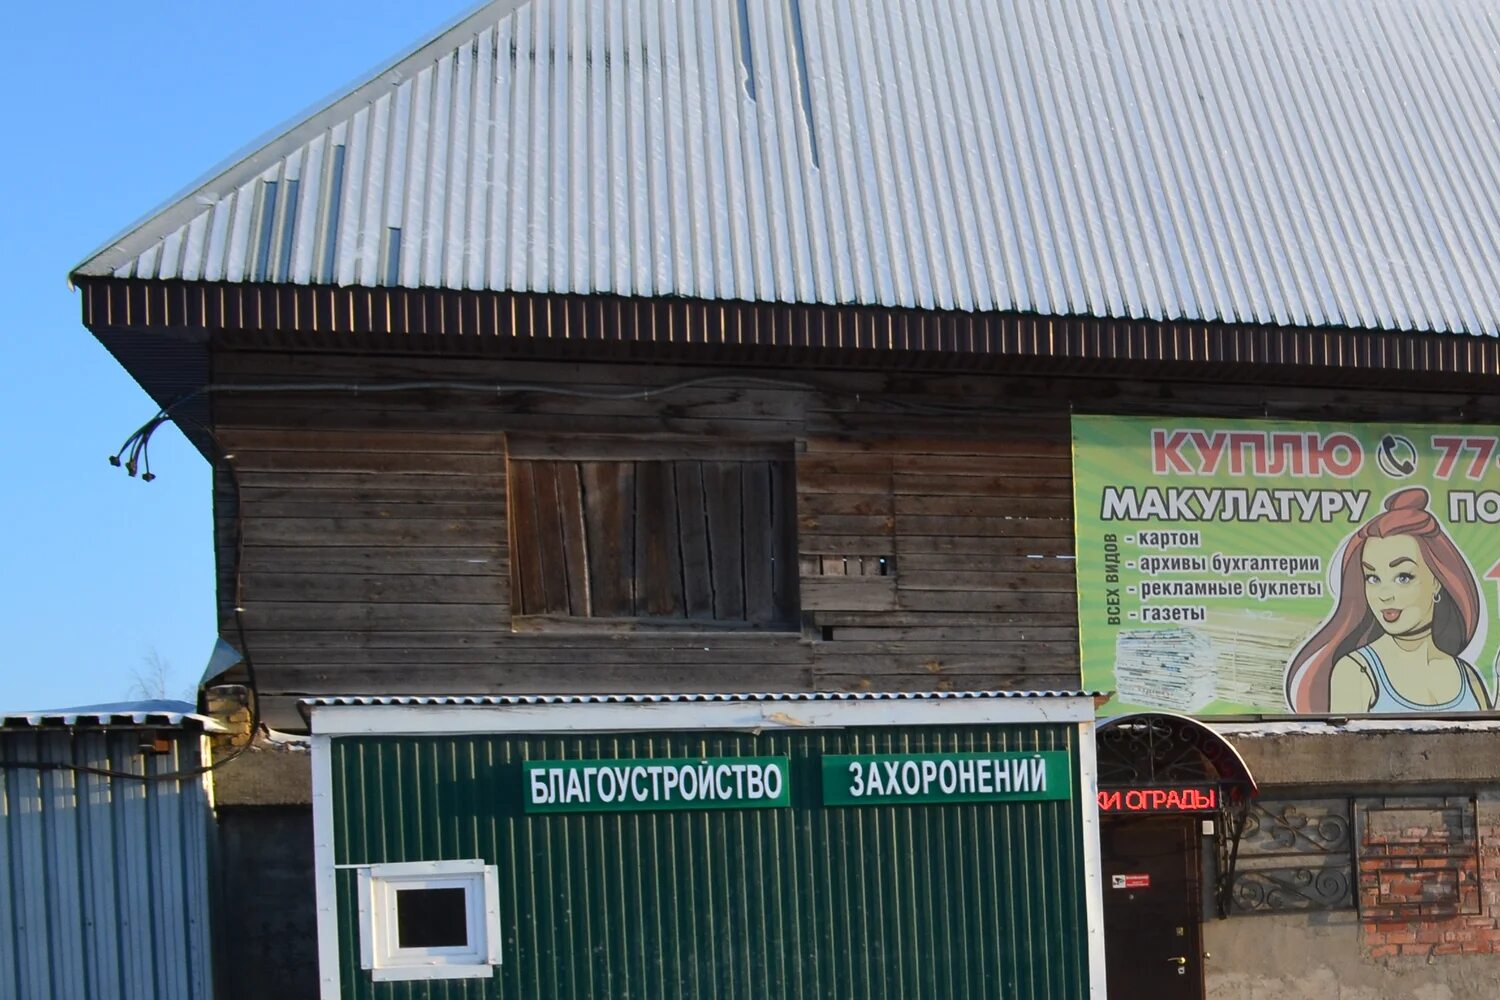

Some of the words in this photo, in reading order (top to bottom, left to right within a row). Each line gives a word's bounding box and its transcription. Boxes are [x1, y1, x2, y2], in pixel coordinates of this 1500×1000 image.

[1152, 430, 1363, 477] КУПЛЮ
[1101, 486, 1370, 522] МАКУЛАТУРУ
[1104, 533, 1121, 583] ВИДОВ
[1138, 531, 1199, 549] картон
[1140, 556, 1206, 574] архивы
[1212, 554, 1320, 574] бухгалтерии
[1106, 588, 1121, 625] ВСЕХ
[1141, 580, 1243, 598] рекламные
[1249, 579, 1322, 598] буклеты
[1142, 606, 1205, 621] газеты
[530, 761, 782, 804] БЛАГОУСТРОЙСТВО
[849, 754, 1047, 797] ЗАХОРОНЕНИЙ
[1126, 789, 1216, 810] ОГРАДЫ
